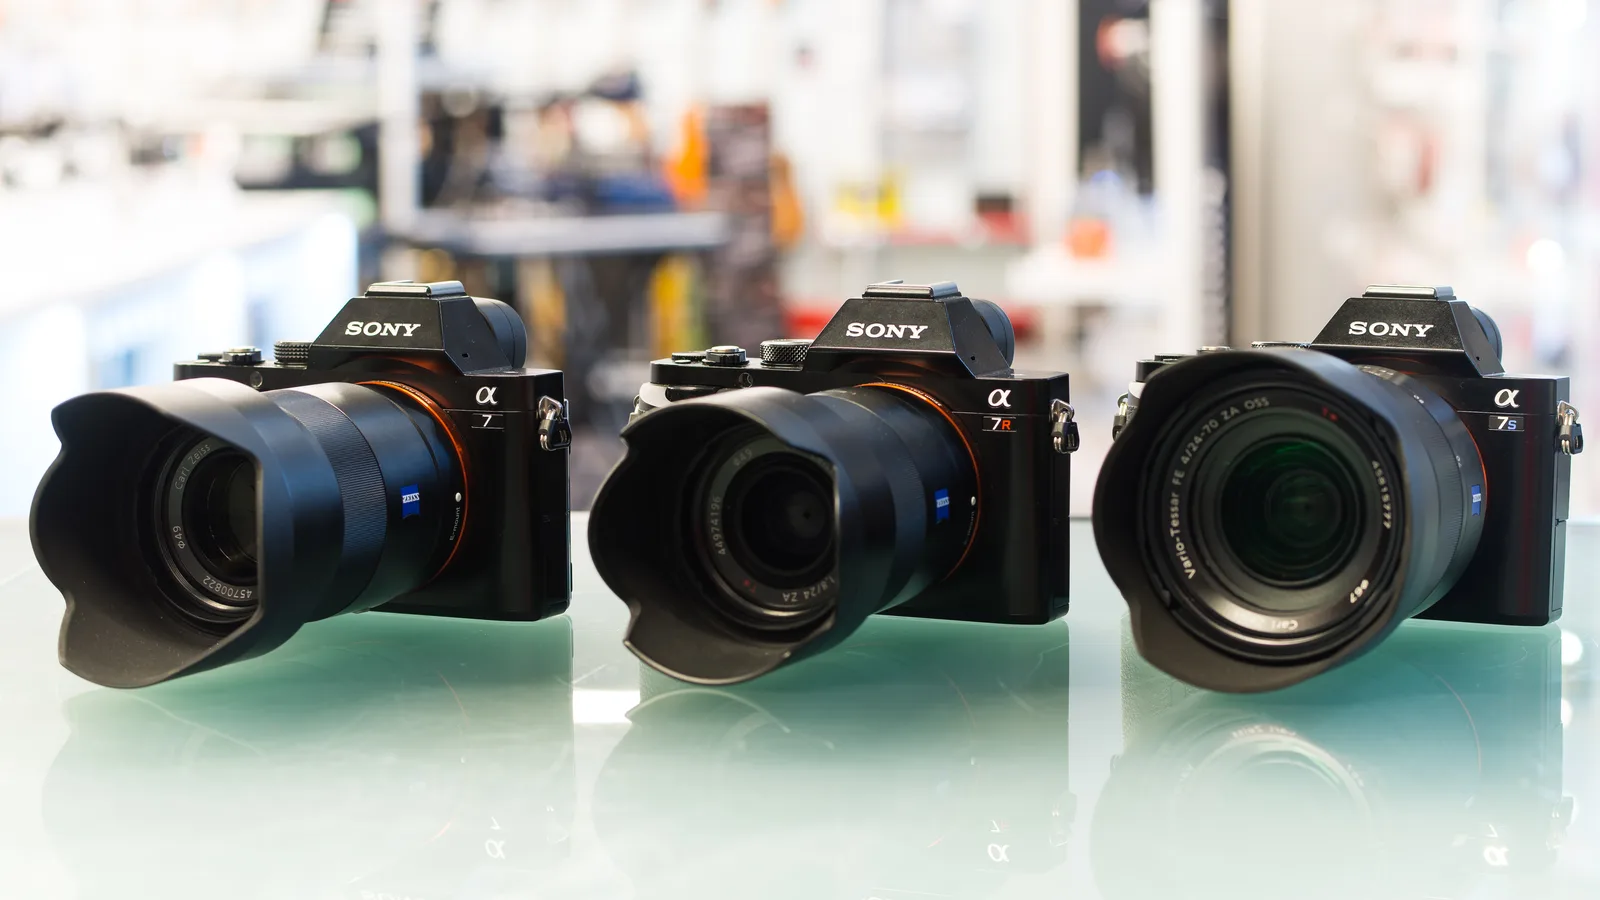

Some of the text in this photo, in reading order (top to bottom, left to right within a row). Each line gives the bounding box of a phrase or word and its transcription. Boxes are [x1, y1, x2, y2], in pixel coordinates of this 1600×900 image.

[344, 321, 421, 337] SONY
[846, 322, 929, 339] SONY
[1348, 321, 1434, 338] SONY
[482, 414, 493, 428] 7
[991, 416, 1012, 431] 7R
[174, 443, 211, 491] Carl Zeiss
[1168, 396, 1271, 580] Vario-Tessar FE 4/24-70 ZA OSS
[202, 575, 253, 600] 45700822
